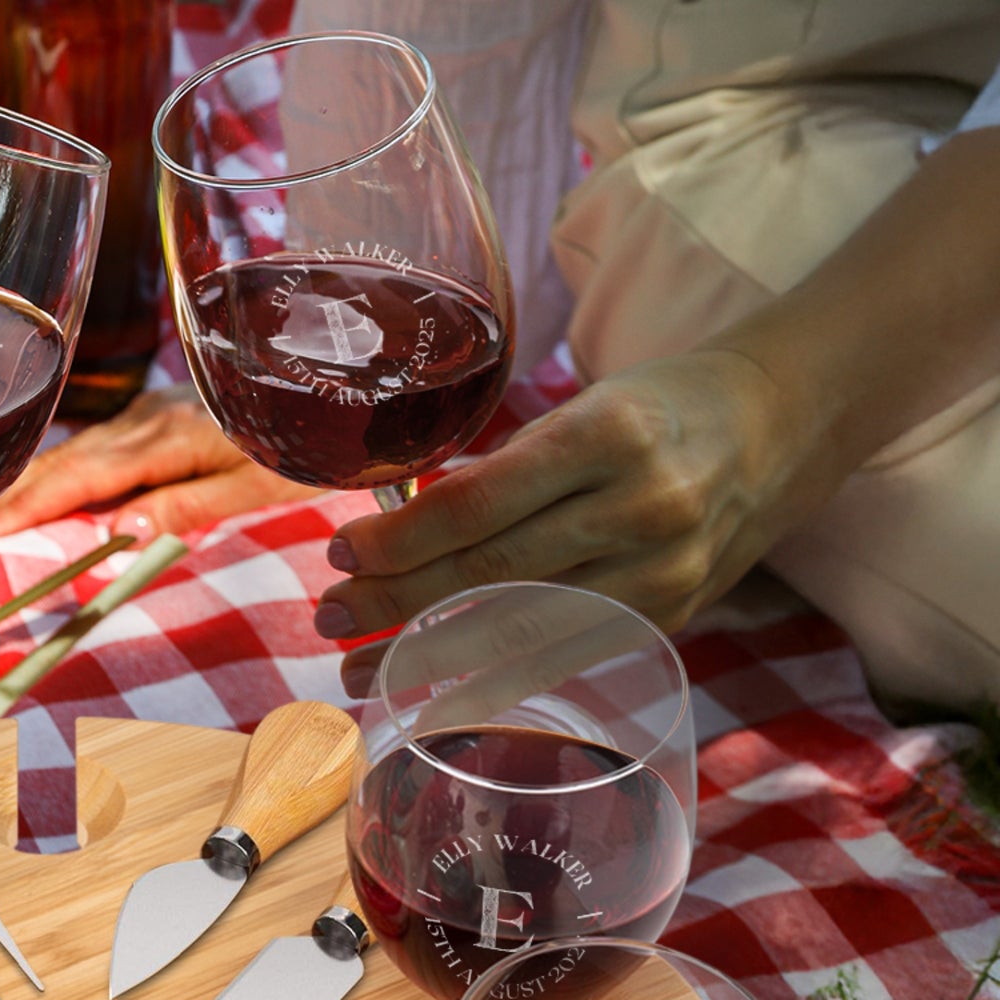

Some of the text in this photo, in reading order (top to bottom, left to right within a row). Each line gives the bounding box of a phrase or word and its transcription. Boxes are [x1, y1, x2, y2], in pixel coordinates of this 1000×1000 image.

[271, 241, 413, 310] ELLY WALKER
[283, 317, 436, 407] 15TH AUGUST 2025
[316, 293, 383, 364] E
[432, 834, 593, 890] ELLY WALKER
[473, 884, 535, 952] E
[425, 917, 587, 1000] 15TH AGUST 202
